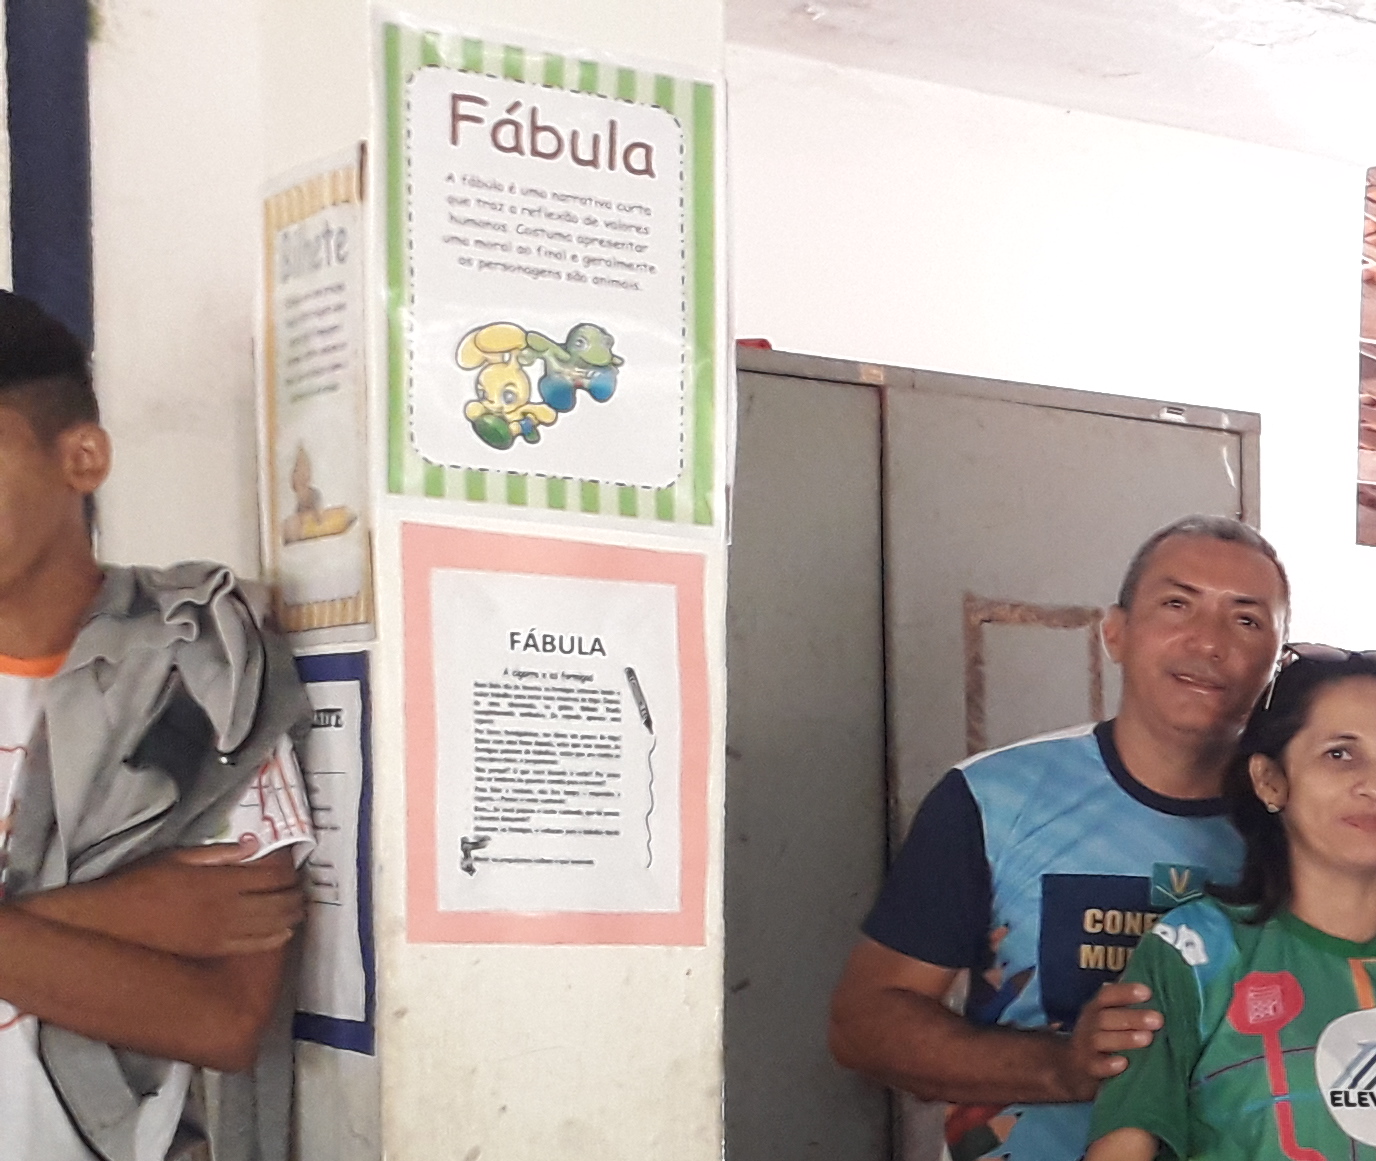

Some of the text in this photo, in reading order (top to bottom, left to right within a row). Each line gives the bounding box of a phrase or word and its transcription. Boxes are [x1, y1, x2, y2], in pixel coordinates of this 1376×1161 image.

[451, 93, 656, 179] Fábula
[446, 172, 455, 183] A
[521, 187, 548, 199] uma
[552, 191, 613, 210] narrativa
[617, 201, 652, 216] curta
[447, 195, 471, 208] que
[476, 198, 504, 212] traz
[521, 206, 579, 223] reflexão
[583, 214, 598, 227] de
[516, 223, 573, 243] Costuma
[577, 233, 649, 253] apresentar
[443, 235, 470, 247] uma
[474, 238, 512, 251] moral
[516, 244, 532, 255] ao
[537, 245, 567, 260] final
[583, 254, 658, 274] geralmente
[478, 258, 562, 280] personagens
[566, 269, 587, 283] são
[509, 628, 607, 656] FÁBULA
[1080, 944, 1134, 972] MU
